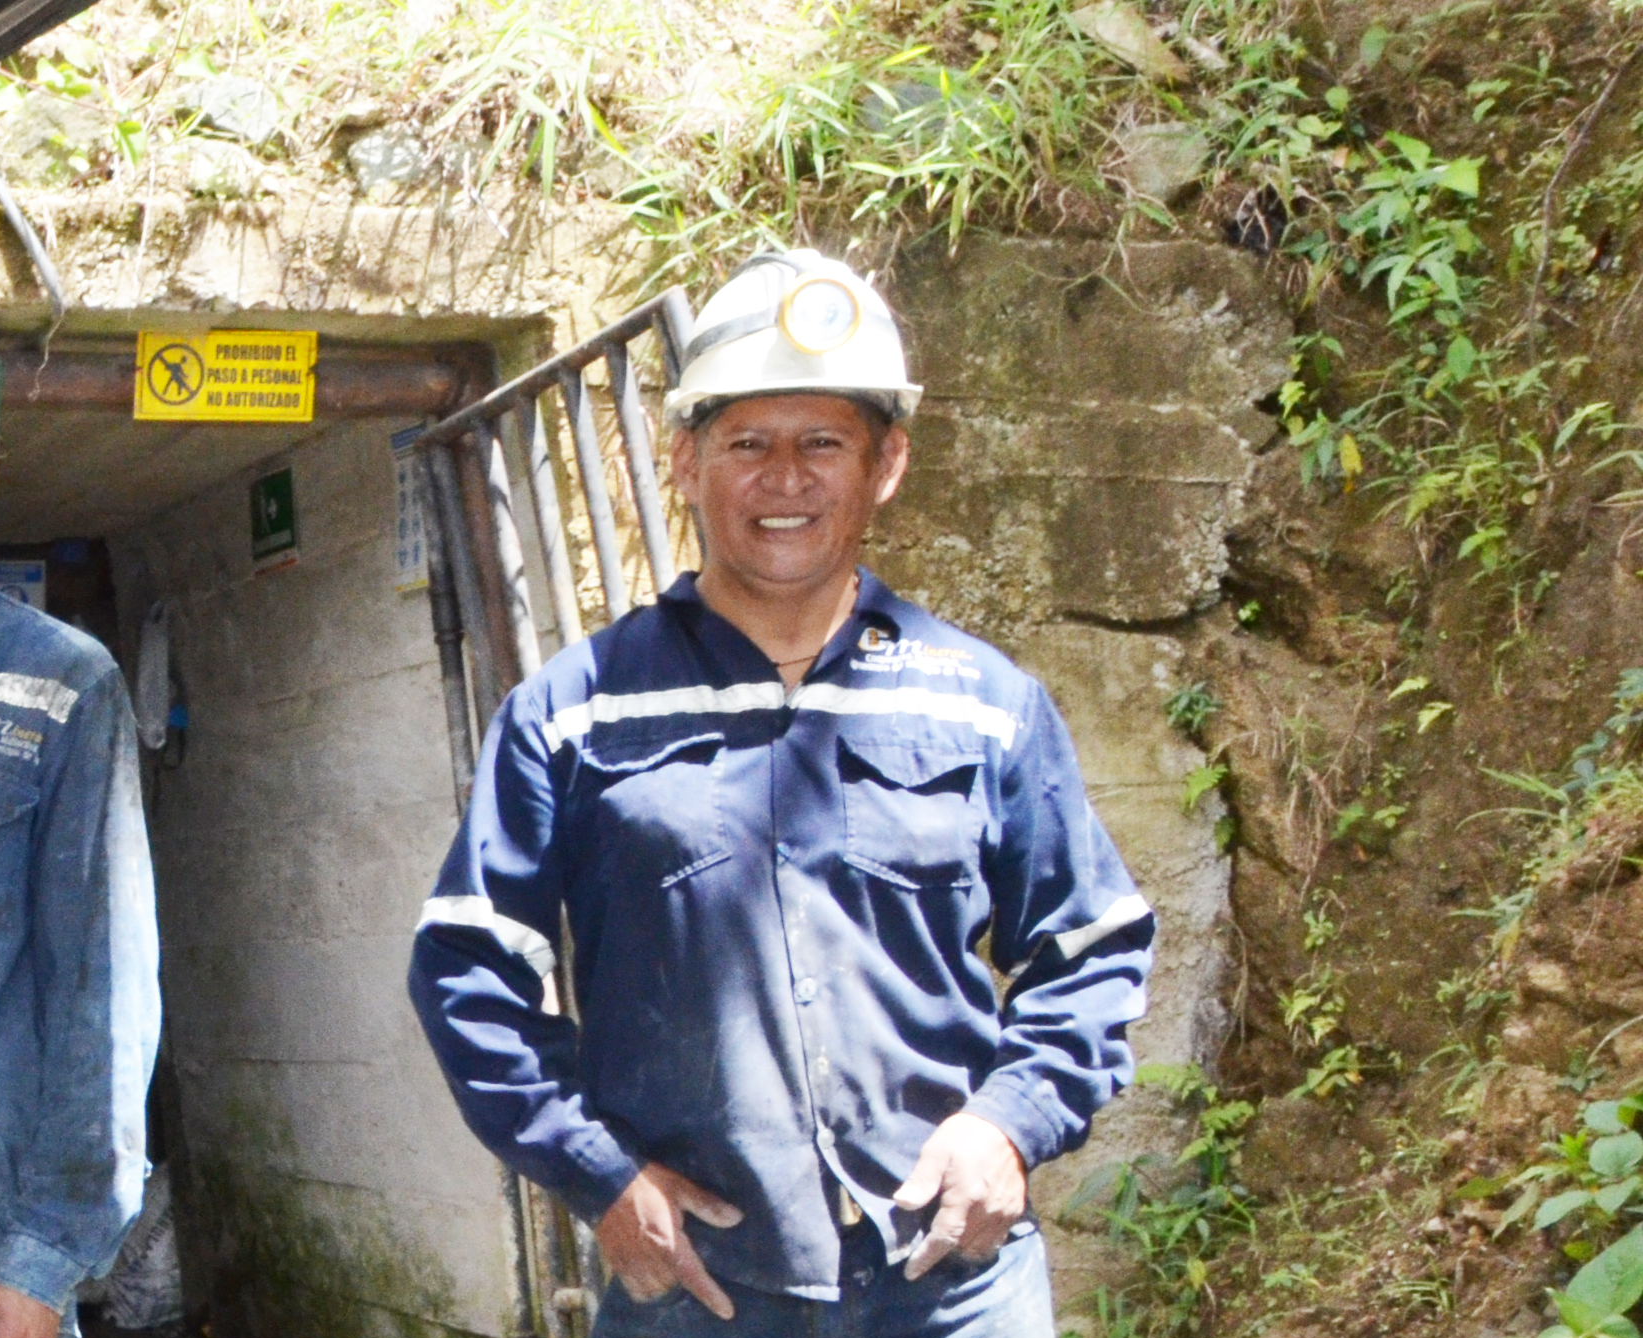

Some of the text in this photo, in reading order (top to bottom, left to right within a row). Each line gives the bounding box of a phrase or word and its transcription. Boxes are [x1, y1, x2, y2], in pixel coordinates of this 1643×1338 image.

[216, 344, 297, 362] PROHIBIDO EL
[206, 368, 236, 384] PASO
[241, 368, 248, 384] A
[206, 391, 300, 408] NO AUTORIZADO
